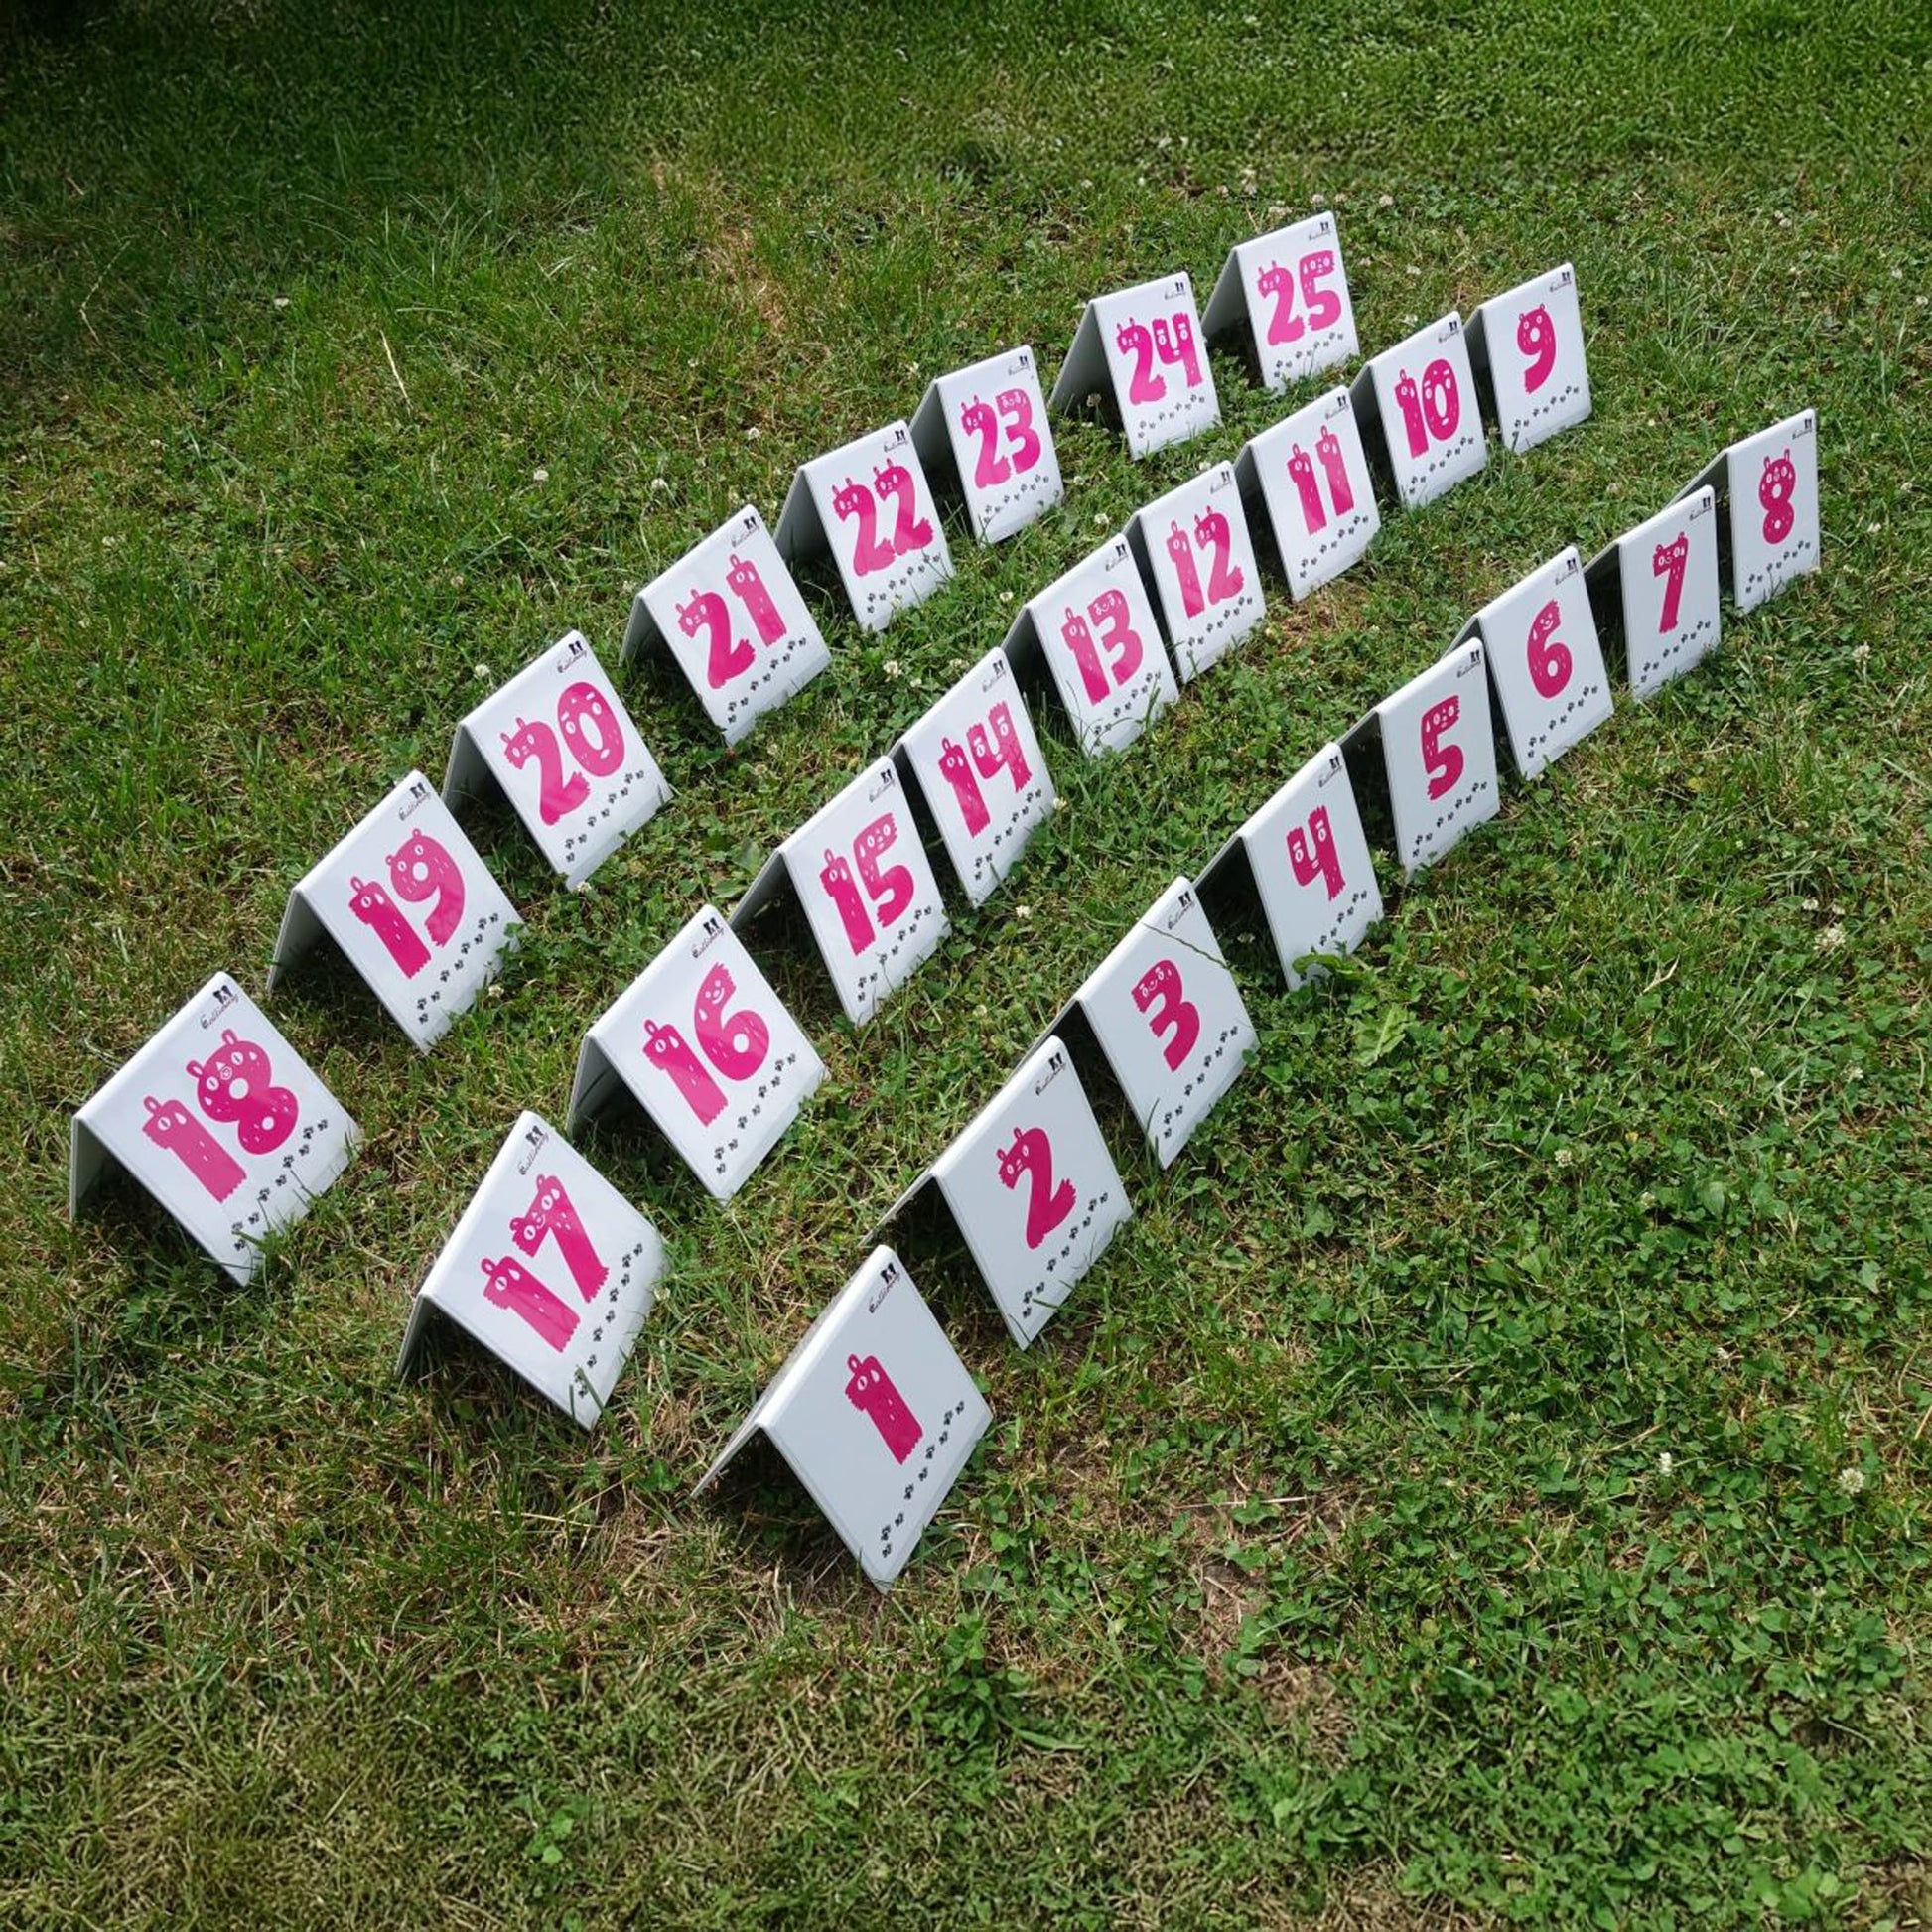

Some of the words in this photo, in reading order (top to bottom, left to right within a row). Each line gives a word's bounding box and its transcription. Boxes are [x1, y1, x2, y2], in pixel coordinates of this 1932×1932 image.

[1257, 249, 1342, 346] 25
[1515, 305, 1557, 395] 9
[1116, 312, 1203, 405] 24
[1394, 357, 1461, 459] 10
[960, 388, 1041, 489] 23
[1287, 425, 1355, 534] 11
[832, 458, 935, 577] 22
[1758, 450, 1797, 545] 8
[1166, 506, 1244, 618] 12
[1652, 533, 1689, 635] 7
[676, 554, 788, 690] 21
[1061, 588, 1144, 705] 13
[1526, 600, 1574, 700] 6
[501, 681, 626, 827] 20
[937, 702, 1032, 838] 14
[1420, 695, 1465, 802] 5
[348, 829, 466, 980] 19
[819, 813, 915, 956] 15
[1286, 805, 1345, 900] 4
[642, 964, 770, 1126] 16
[1131, 958, 1201, 1071] 3
[142, 1029, 300, 1202] 18
[996, 1127, 1076, 1250] 2
[480, 1175, 610, 1353] 17
[845, 1354, 923, 1465] 1
